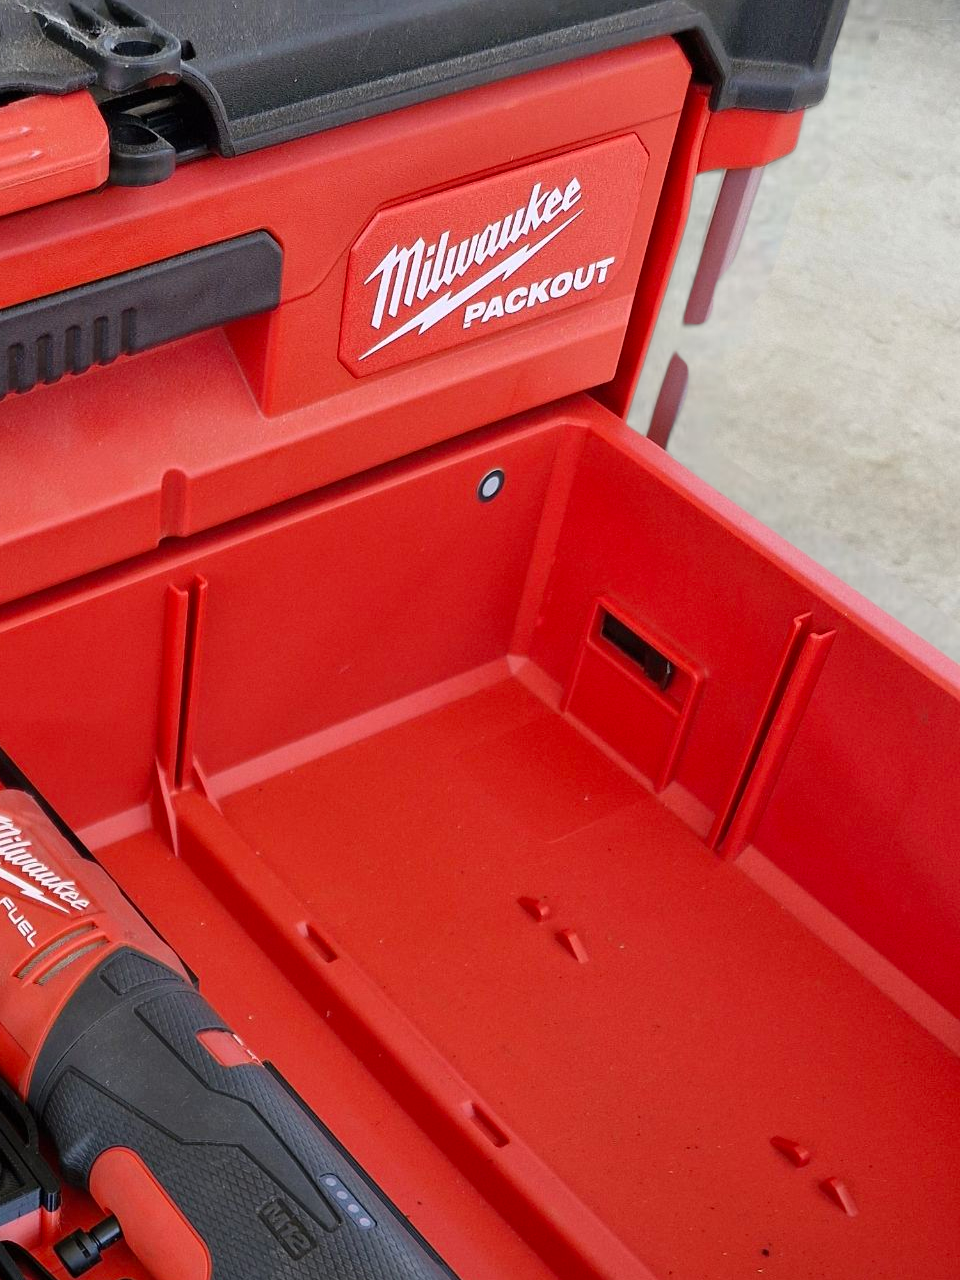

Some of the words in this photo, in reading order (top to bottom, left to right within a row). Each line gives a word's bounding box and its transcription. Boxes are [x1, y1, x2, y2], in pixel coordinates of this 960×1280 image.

[363, 176, 582, 331] Milwaukee
[462, 256, 616, 330] PACKOUT
[262, 1199, 313, 1256] M12
